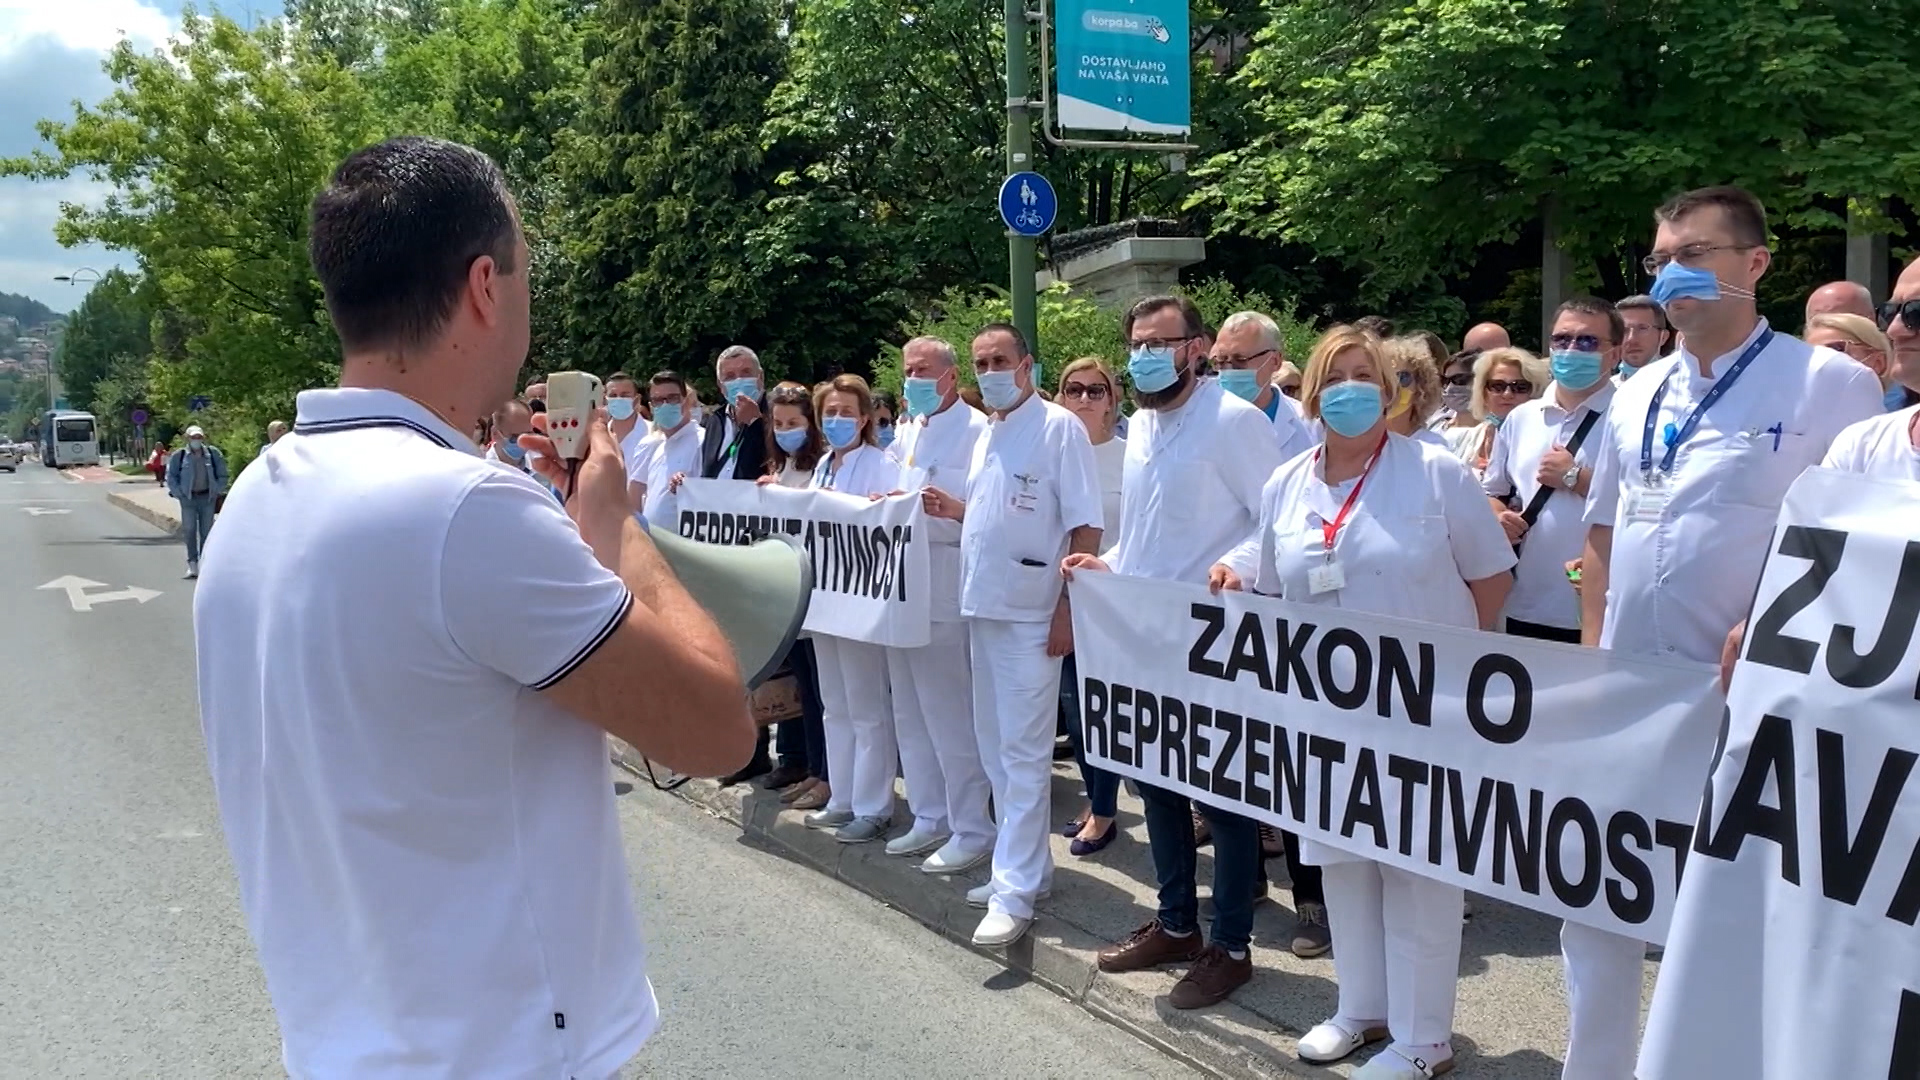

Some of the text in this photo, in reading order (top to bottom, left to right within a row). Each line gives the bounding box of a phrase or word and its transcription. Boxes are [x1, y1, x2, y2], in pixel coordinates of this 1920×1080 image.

[1091, 15, 1138, 30] korpa.ba
[1081, 55, 1167, 72] DOSTAVLJAMO
[1078, 69, 1170, 86] NA VAŠA VRATA
[1188, 602, 1534, 744] ZAKON O
